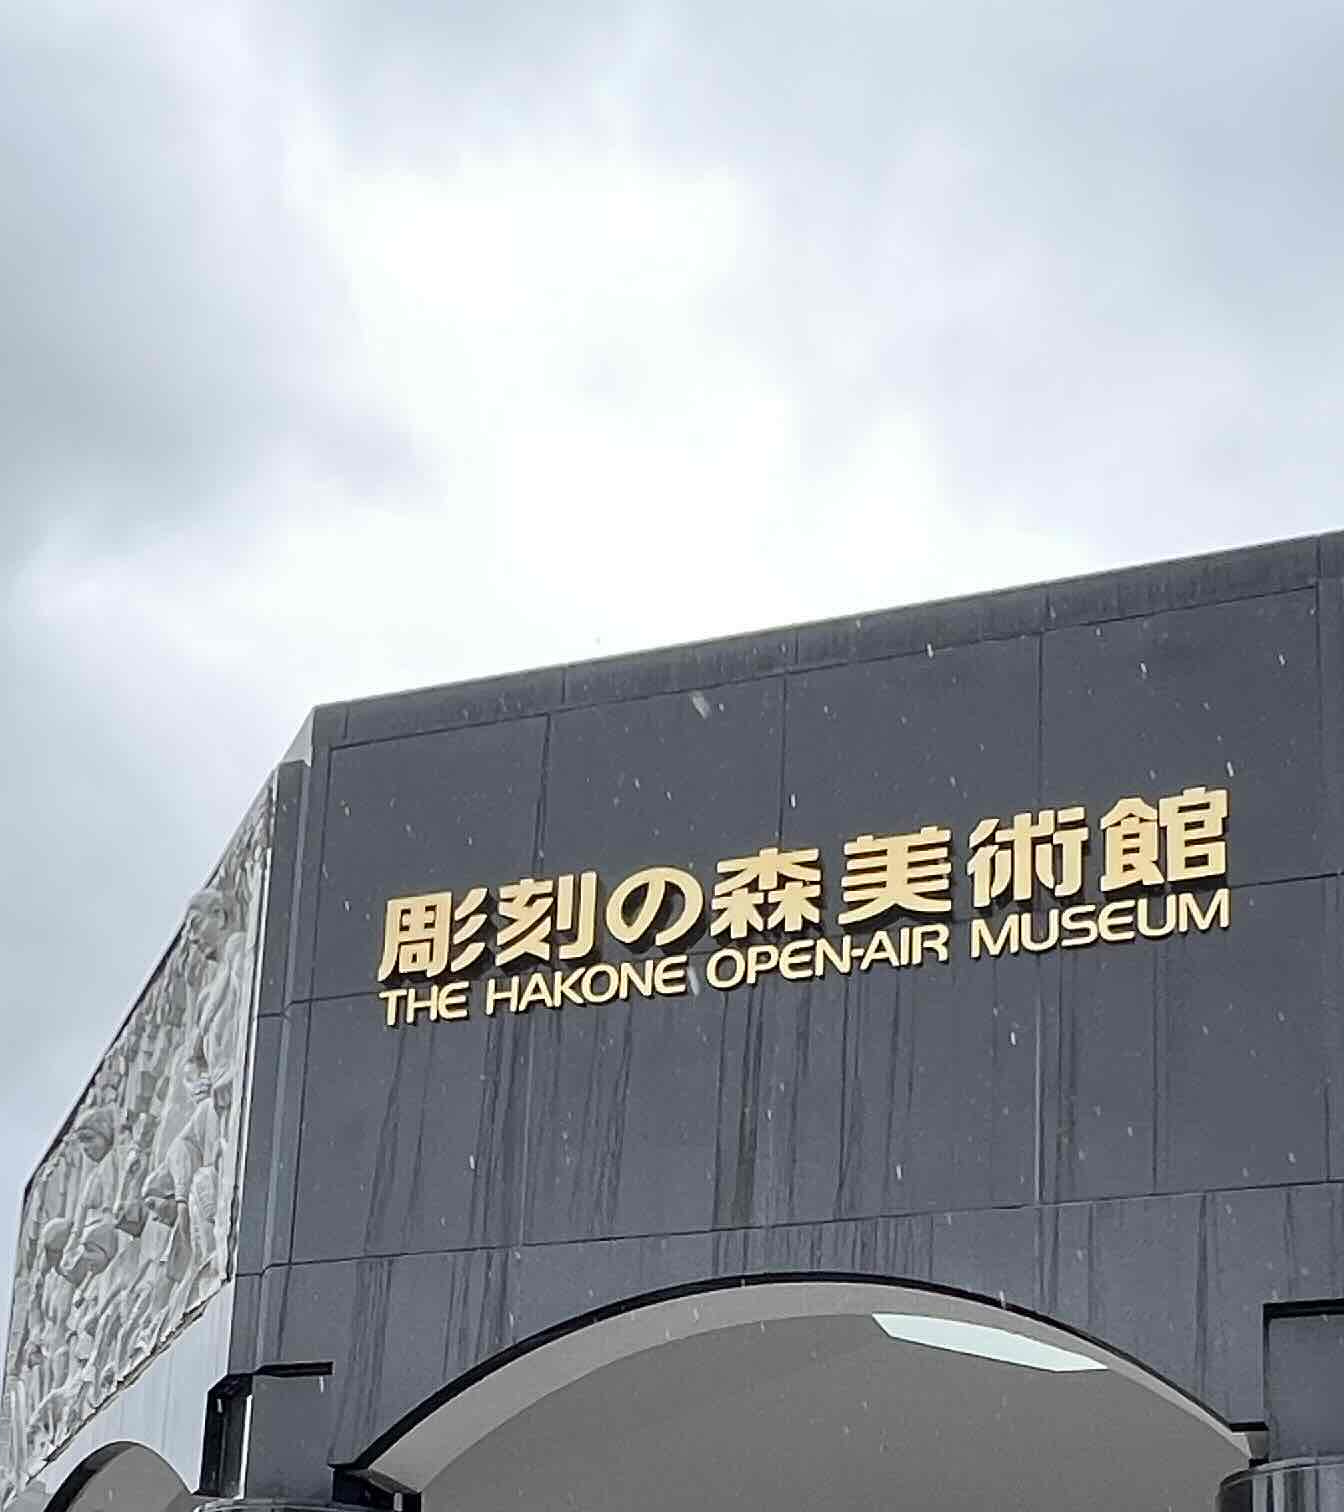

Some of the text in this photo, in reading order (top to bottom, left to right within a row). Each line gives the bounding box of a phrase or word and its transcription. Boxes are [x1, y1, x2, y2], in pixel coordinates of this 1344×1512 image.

[377, 786, 1229, 982] 彫刻の森美術館
[379, 888, 1230, 1027] THE HAKONE OPEN-AIR MUSEUM
